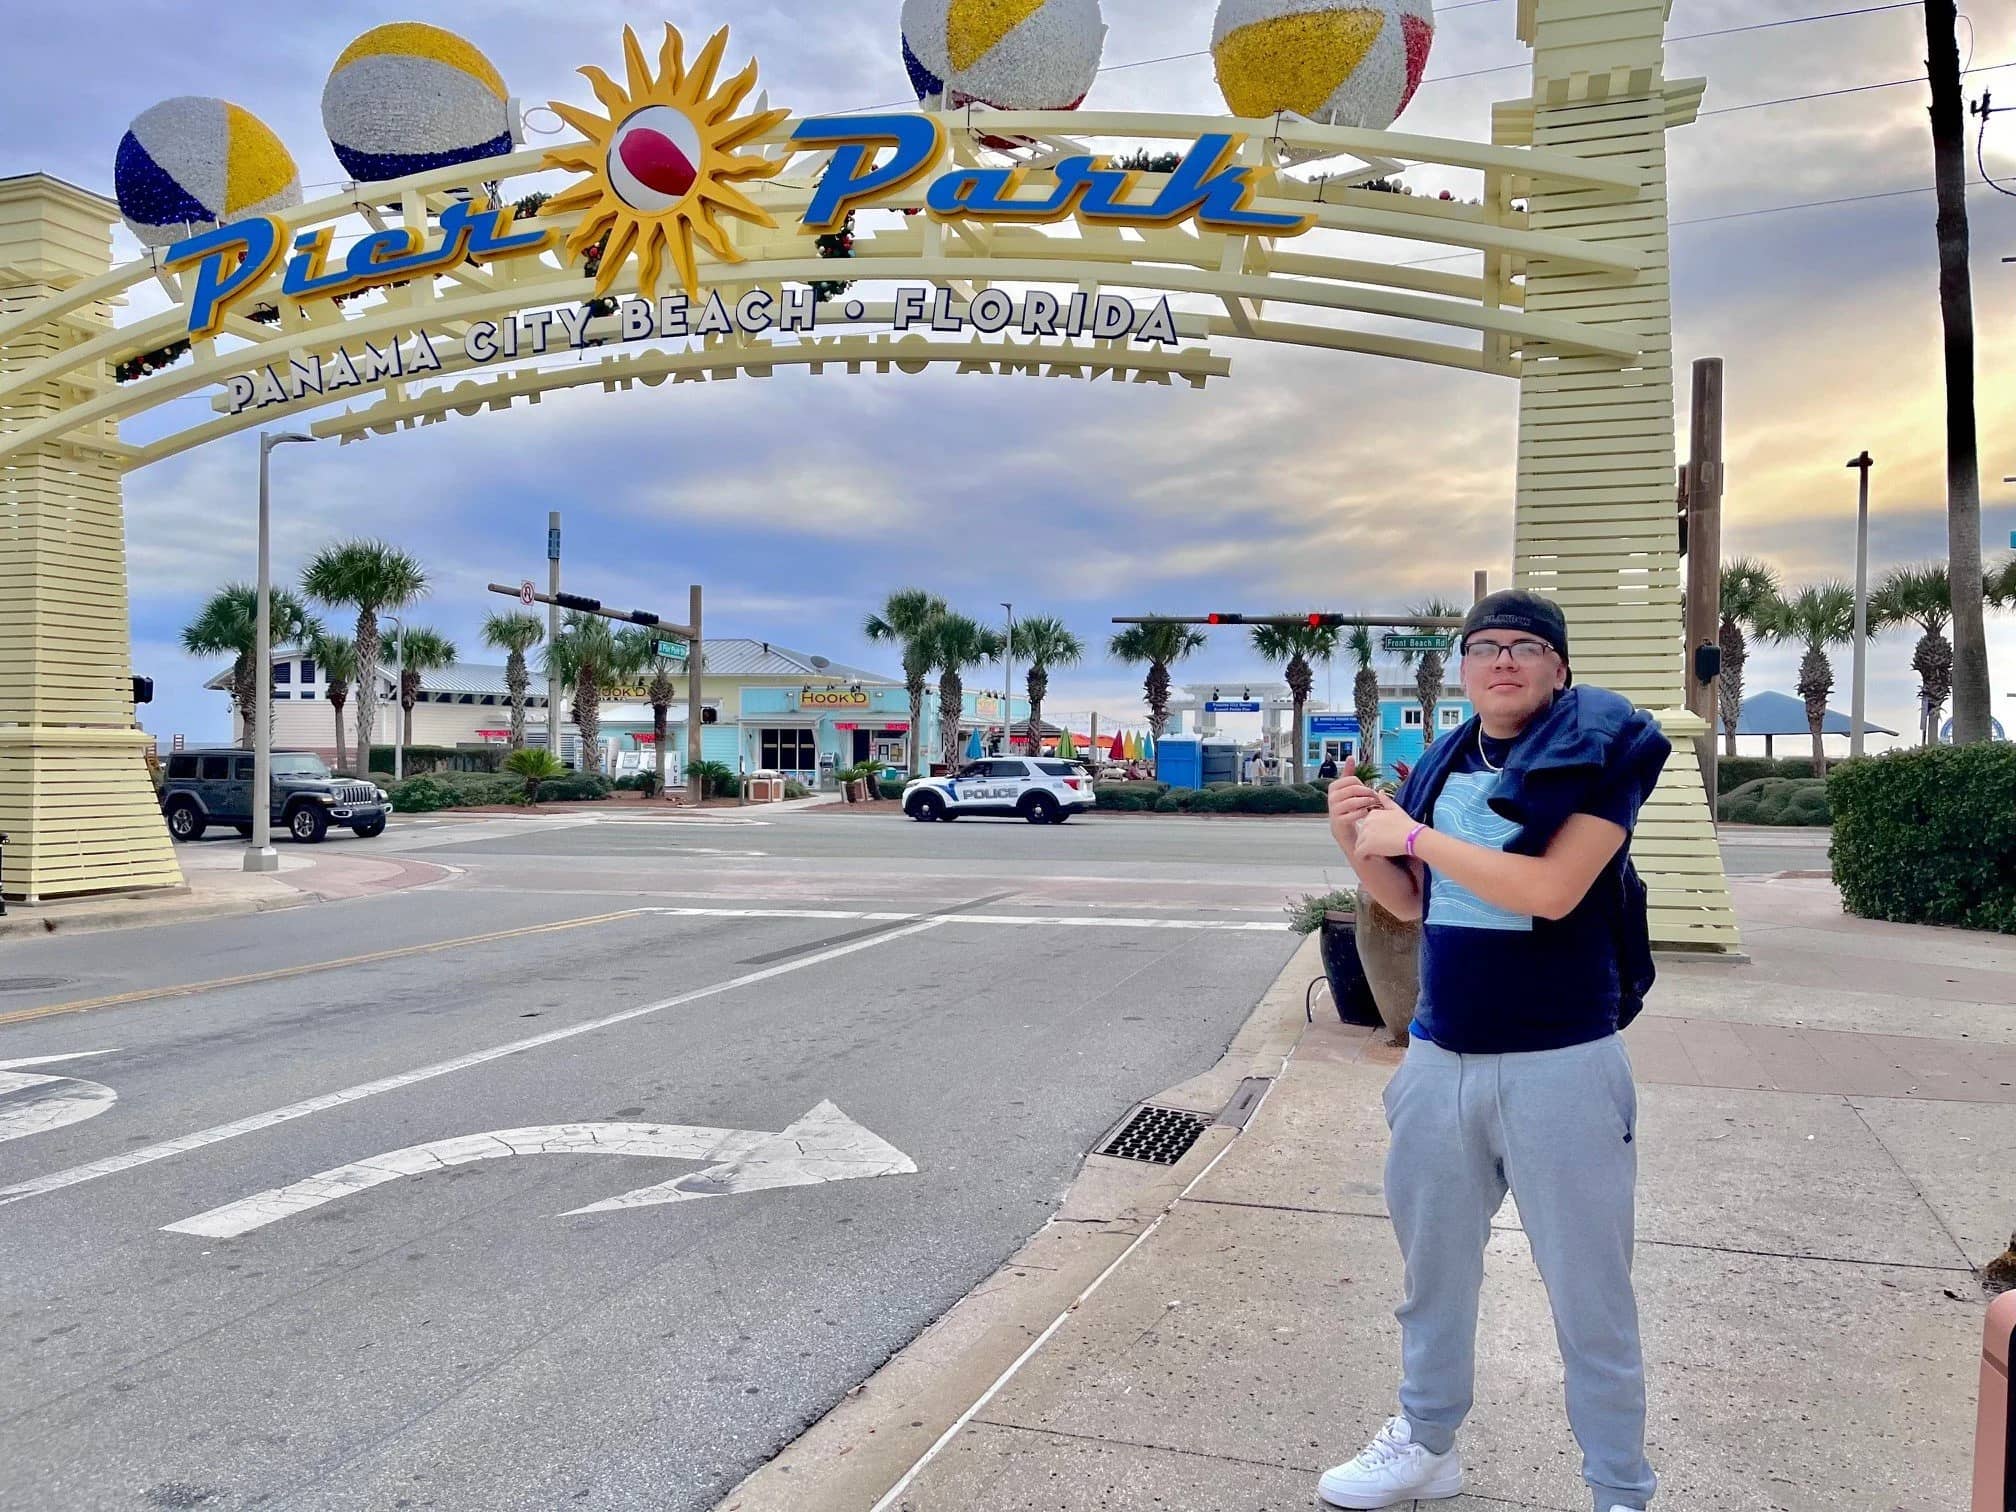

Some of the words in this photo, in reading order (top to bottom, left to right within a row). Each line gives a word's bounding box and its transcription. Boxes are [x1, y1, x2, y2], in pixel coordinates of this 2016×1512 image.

[165, 201, 560, 340] Pier
[787, 113, 1312, 232] Park
[227, 328, 441, 415] PANAMA
[464, 305, 592, 362] CITY
[622, 288, 818, 343] BEACH
[893, 287, 1178, 346] FLORIDA
[1387, 638, 1406, 647] Front
[1409, 638, 1432, 647] Beach
[1435, 638, 1446, 647] Rd
[601, 686, 647, 697] OOK'D
[801, 692, 867, 704] HOOK'D
[962, 787, 1018, 800] POLICE
